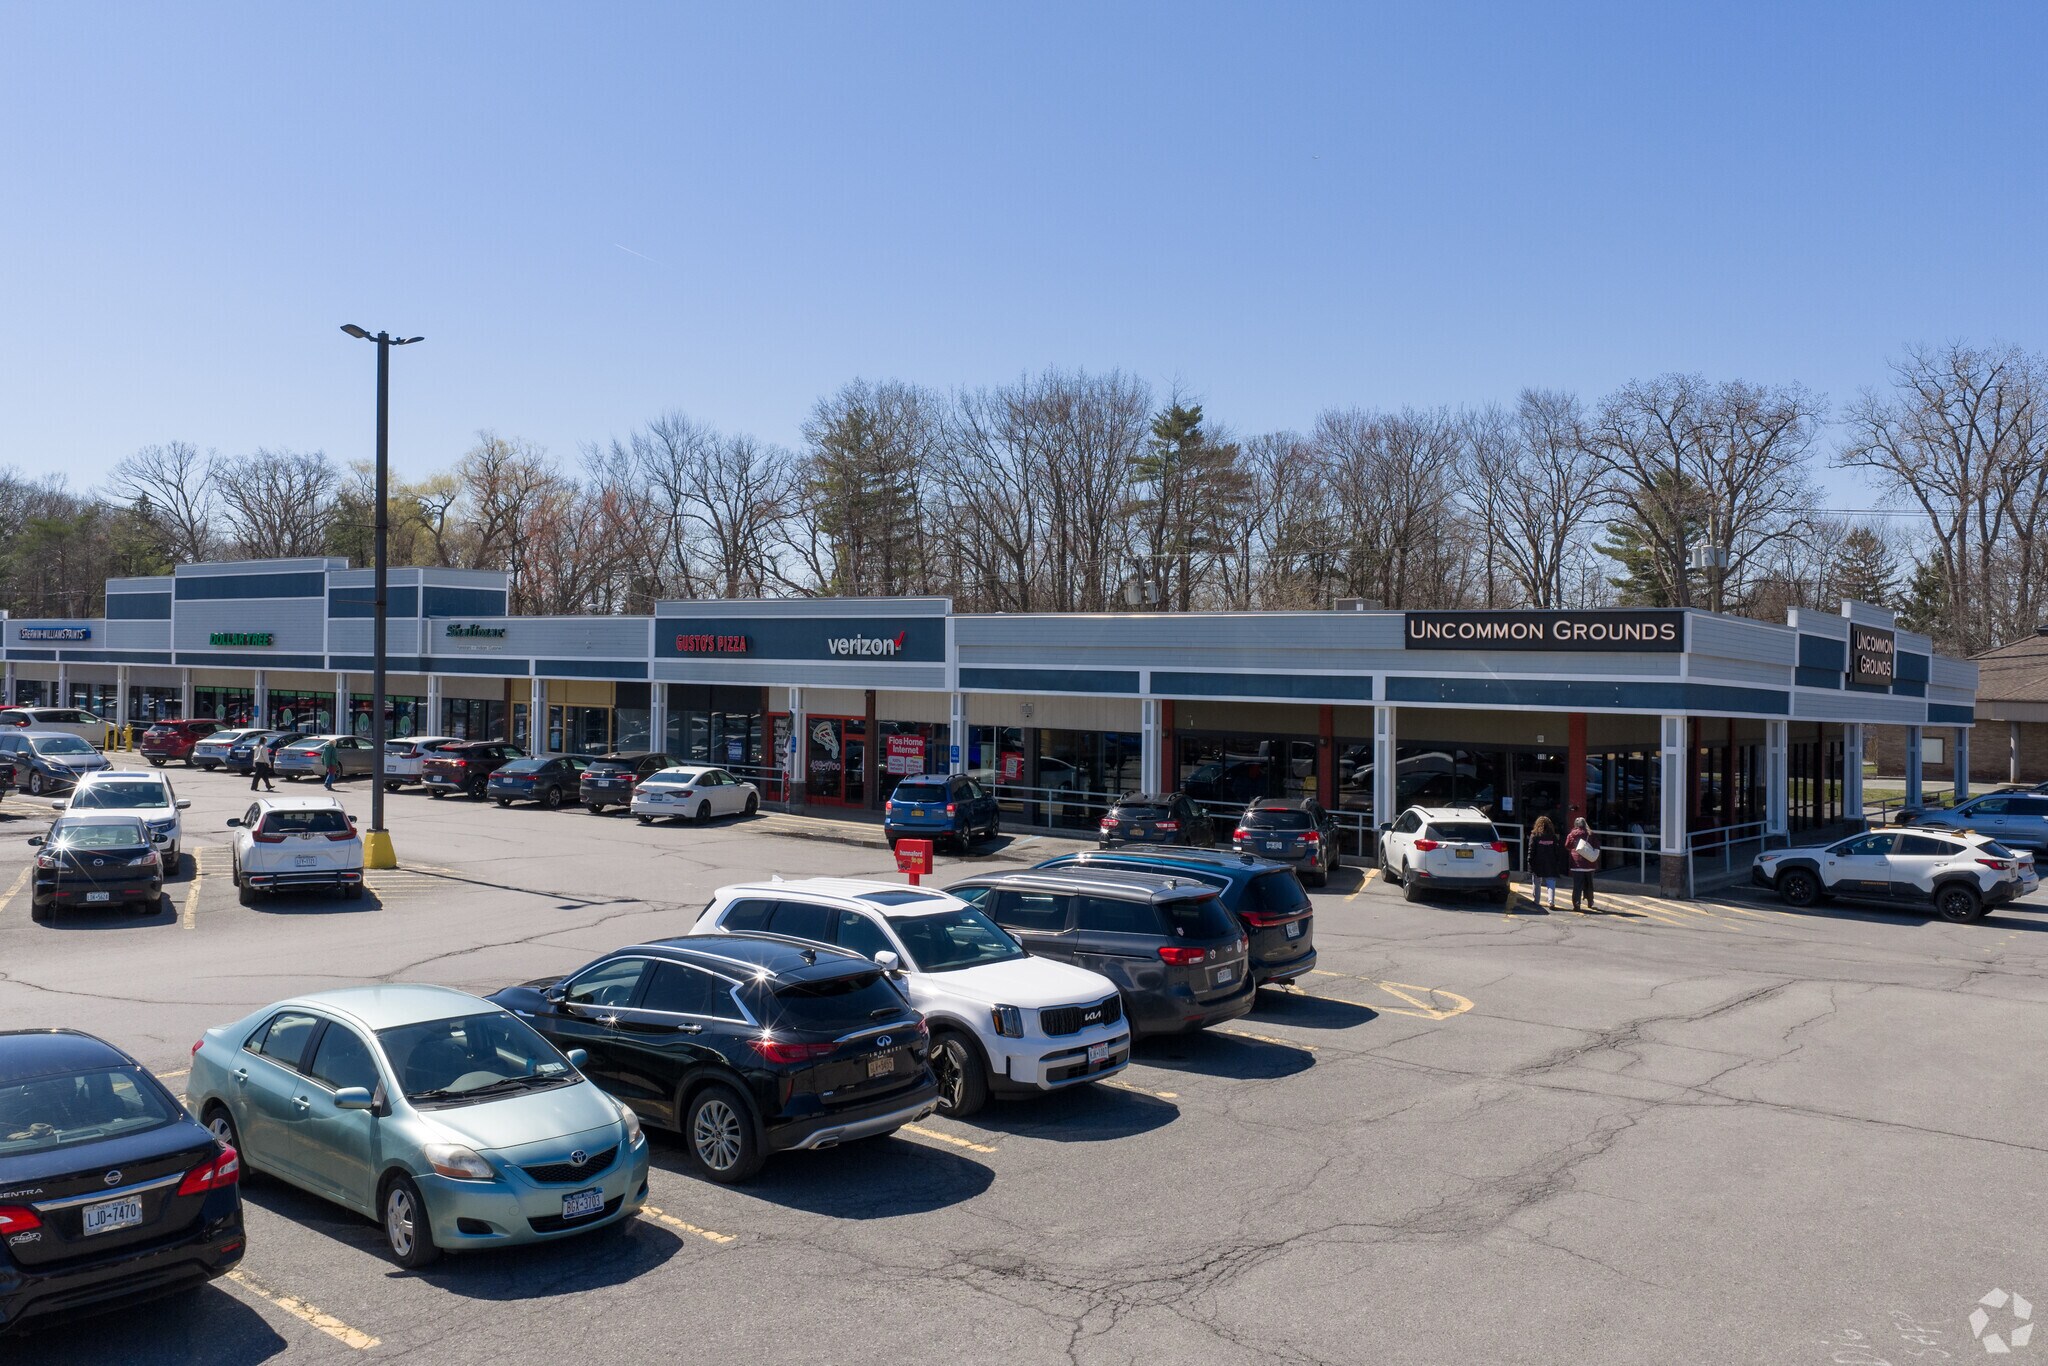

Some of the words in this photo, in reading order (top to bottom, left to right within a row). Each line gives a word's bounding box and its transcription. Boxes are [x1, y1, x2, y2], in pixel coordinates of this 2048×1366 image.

[209, 632, 245, 646] DOLLAR
[247, 632, 269, 646] TREE
[1410, 620, 1544, 640] UNCOMMON
[1552, 621, 1676, 641] GROUNDS
[676, 634, 715, 652] GUSTO'S
[717, 635, 747, 652] PIZZA
[827, 633, 895, 656] verizon
[1856, 631, 1893, 654] UNCOMMON
[1860, 655, 1891, 676] GROUNDS
[888, 737, 902, 745] Fios
[903, 738, 924, 747] Home
[892, 745, 919, 755] Internet
